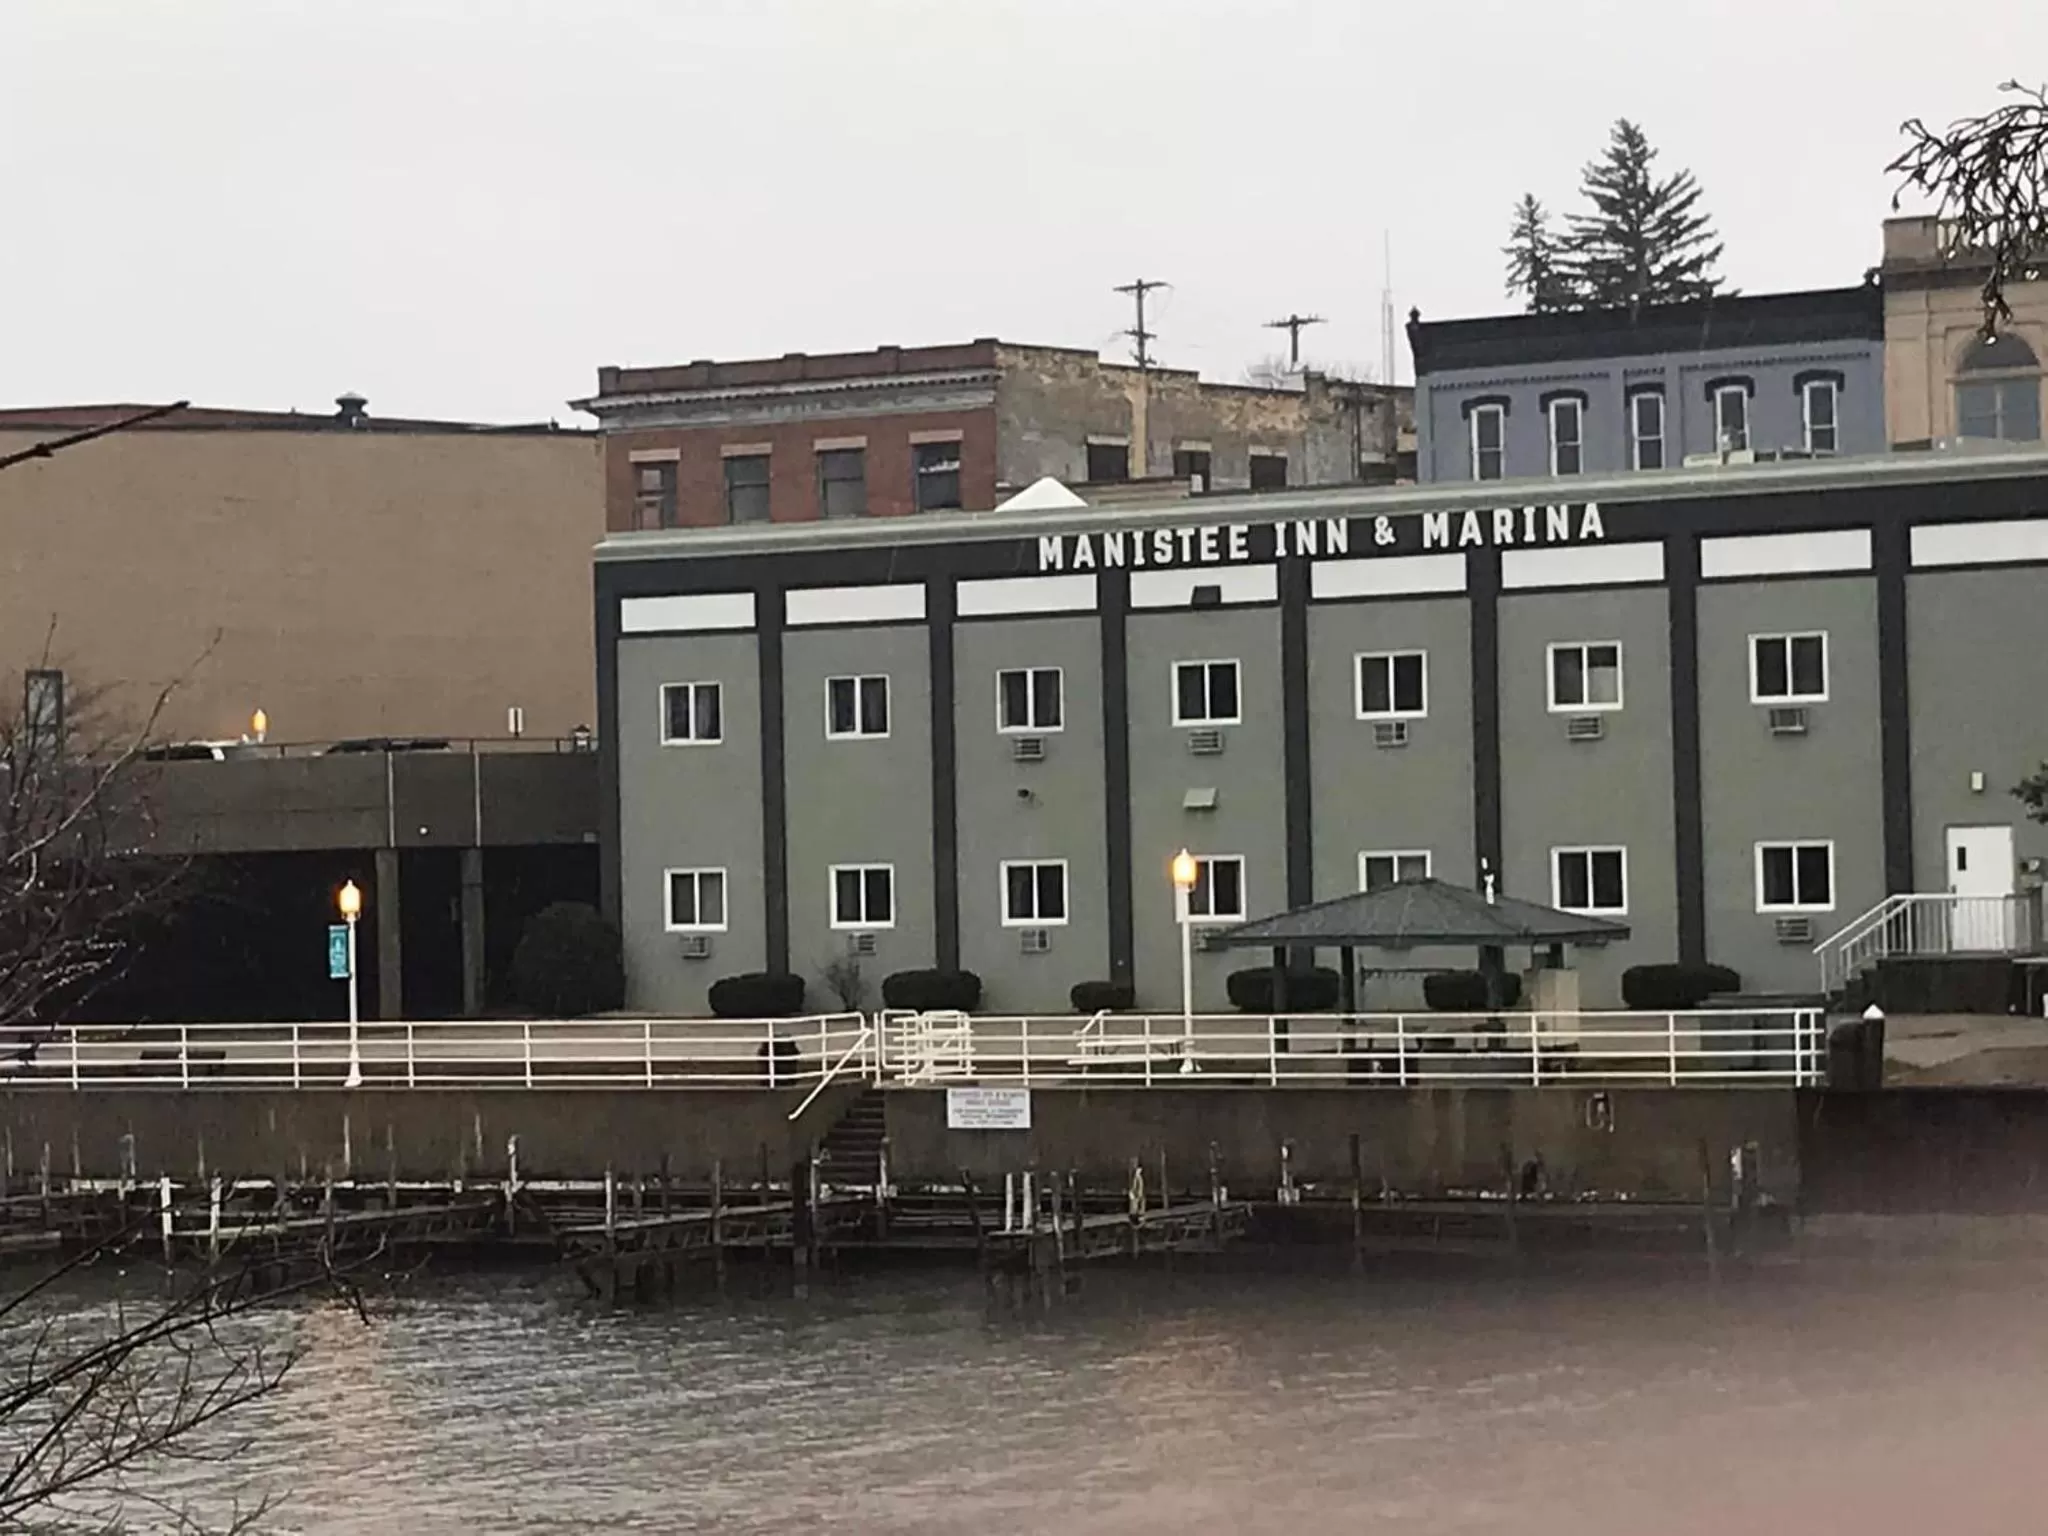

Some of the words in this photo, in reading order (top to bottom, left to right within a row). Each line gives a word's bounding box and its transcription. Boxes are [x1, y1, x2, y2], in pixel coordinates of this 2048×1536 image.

[1039, 524, 1249, 571] MANISTEE
[1275, 518, 1348, 557] INN
[1374, 515, 1396, 546] &
[1423, 502, 1604, 548] MARINA
